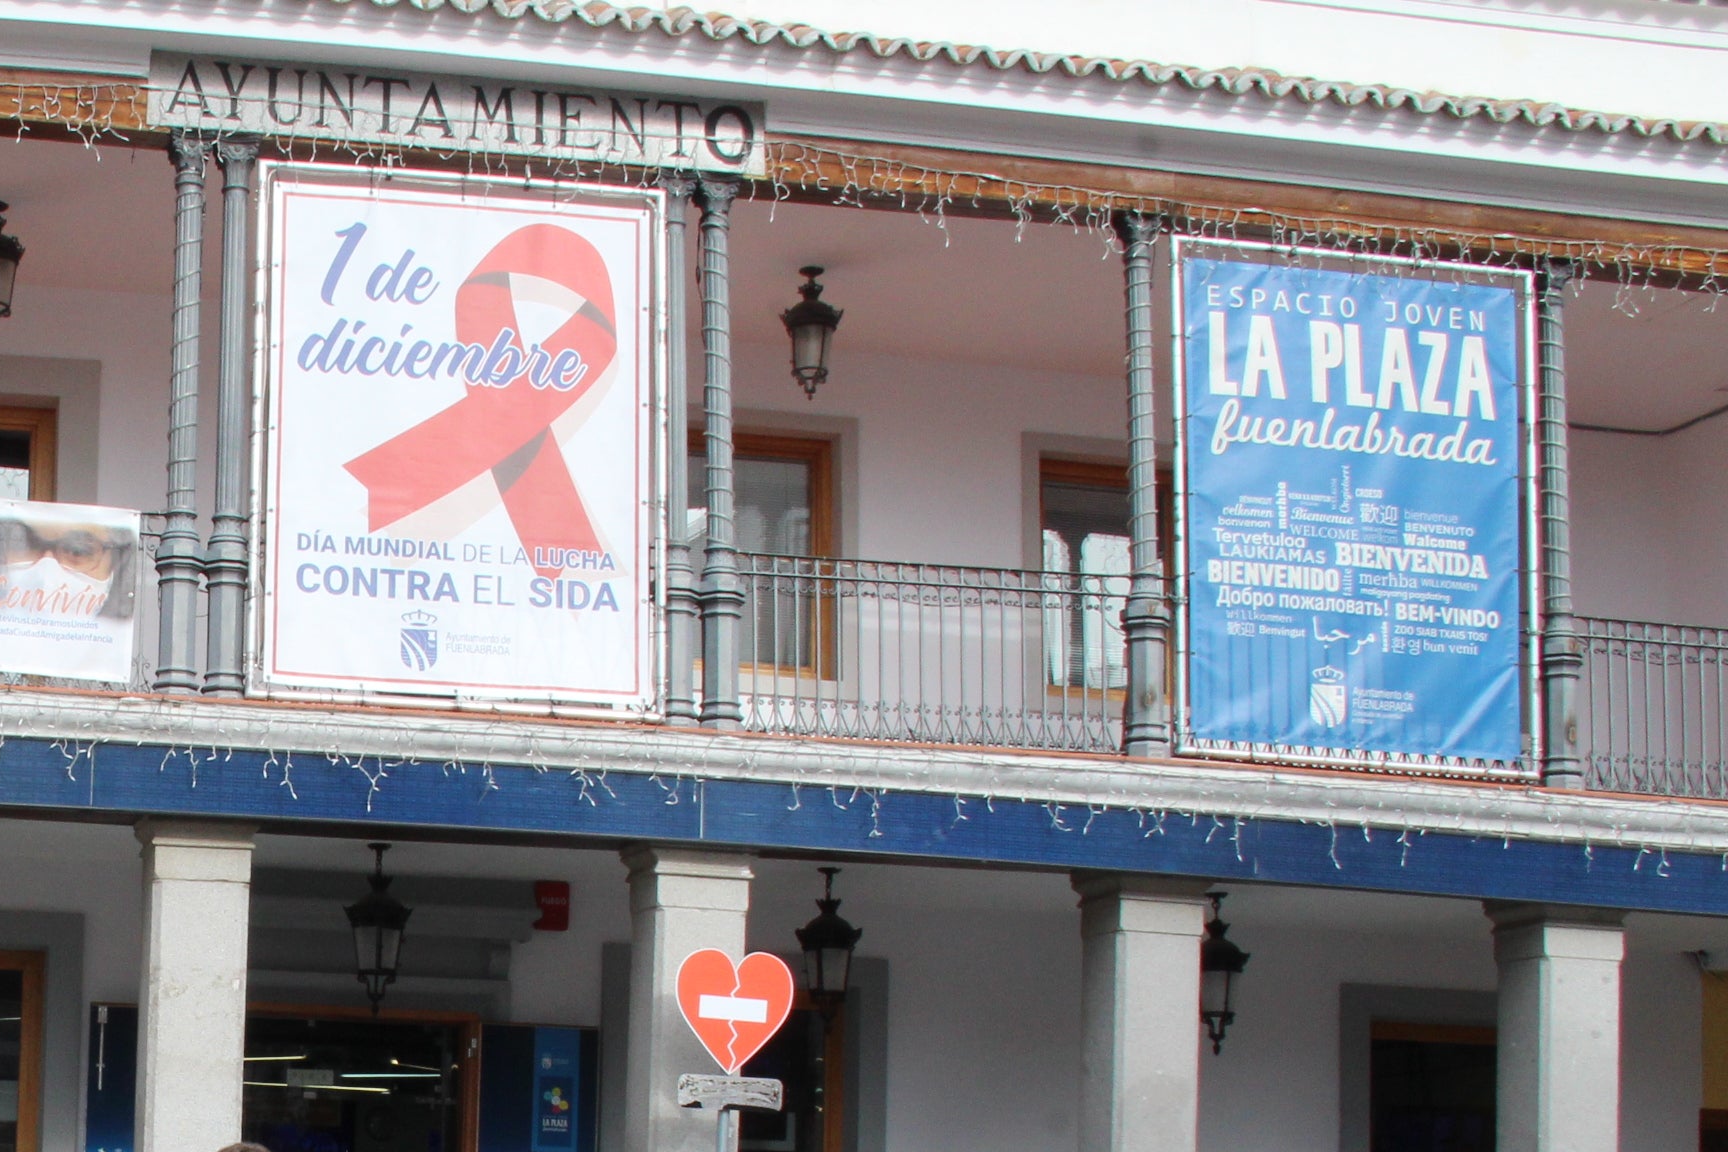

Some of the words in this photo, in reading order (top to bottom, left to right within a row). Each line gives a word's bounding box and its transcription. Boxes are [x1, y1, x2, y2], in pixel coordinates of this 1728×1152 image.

[165, 58, 756, 167] AYUNTAMIENTO
[319, 220, 367, 308] 1
[366, 245, 441, 307] de
[1206, 285, 1357, 318] ESPACIO
[1384, 299, 1486, 332] JOVEN
[297, 317, 590, 392] diciembre
[1208, 310, 1287, 401] LA
[1309, 319, 1496, 422] PLAZA
[1210, 398, 1498, 466] fuenlabrada
[1290, 507, 1354, 525] Bienvenue
[1404, 522, 1475, 537] BENVENUTO
[1212, 527, 1307, 549] Tervetuloa
[1290, 524, 1359, 541] WELCOME
[296, 529, 337, 553] DÍA
[345, 535, 454, 562] MUNDIAL
[462, 544, 492, 564] DE
[499, 546, 528, 566] LA
[534, 547, 615, 571] LUCHA
[1219, 543, 1327, 565] LAUKIAMAS
[1334, 542, 1489, 580] BIENVENIDA
[295, 563, 460, 603] CONTRA
[473, 574, 516, 606] EL
[528, 576, 619, 612] SIDA
[1207, 559, 1341, 593] BIENVENIDO
[1359, 572, 1418, 589] merhba
[1216, 585, 1275, 610] Добро
[1279, 593, 1389, 617] пожаловать!
[1395, 602, 1501, 629] BEM-VINDO
[445, 643, 511, 656] FUENLABRADA
[1423, 638, 1445, 652] bun
[1448, 642, 1479, 655] venit
[1352, 698, 1414, 712] FUENLABRADA
